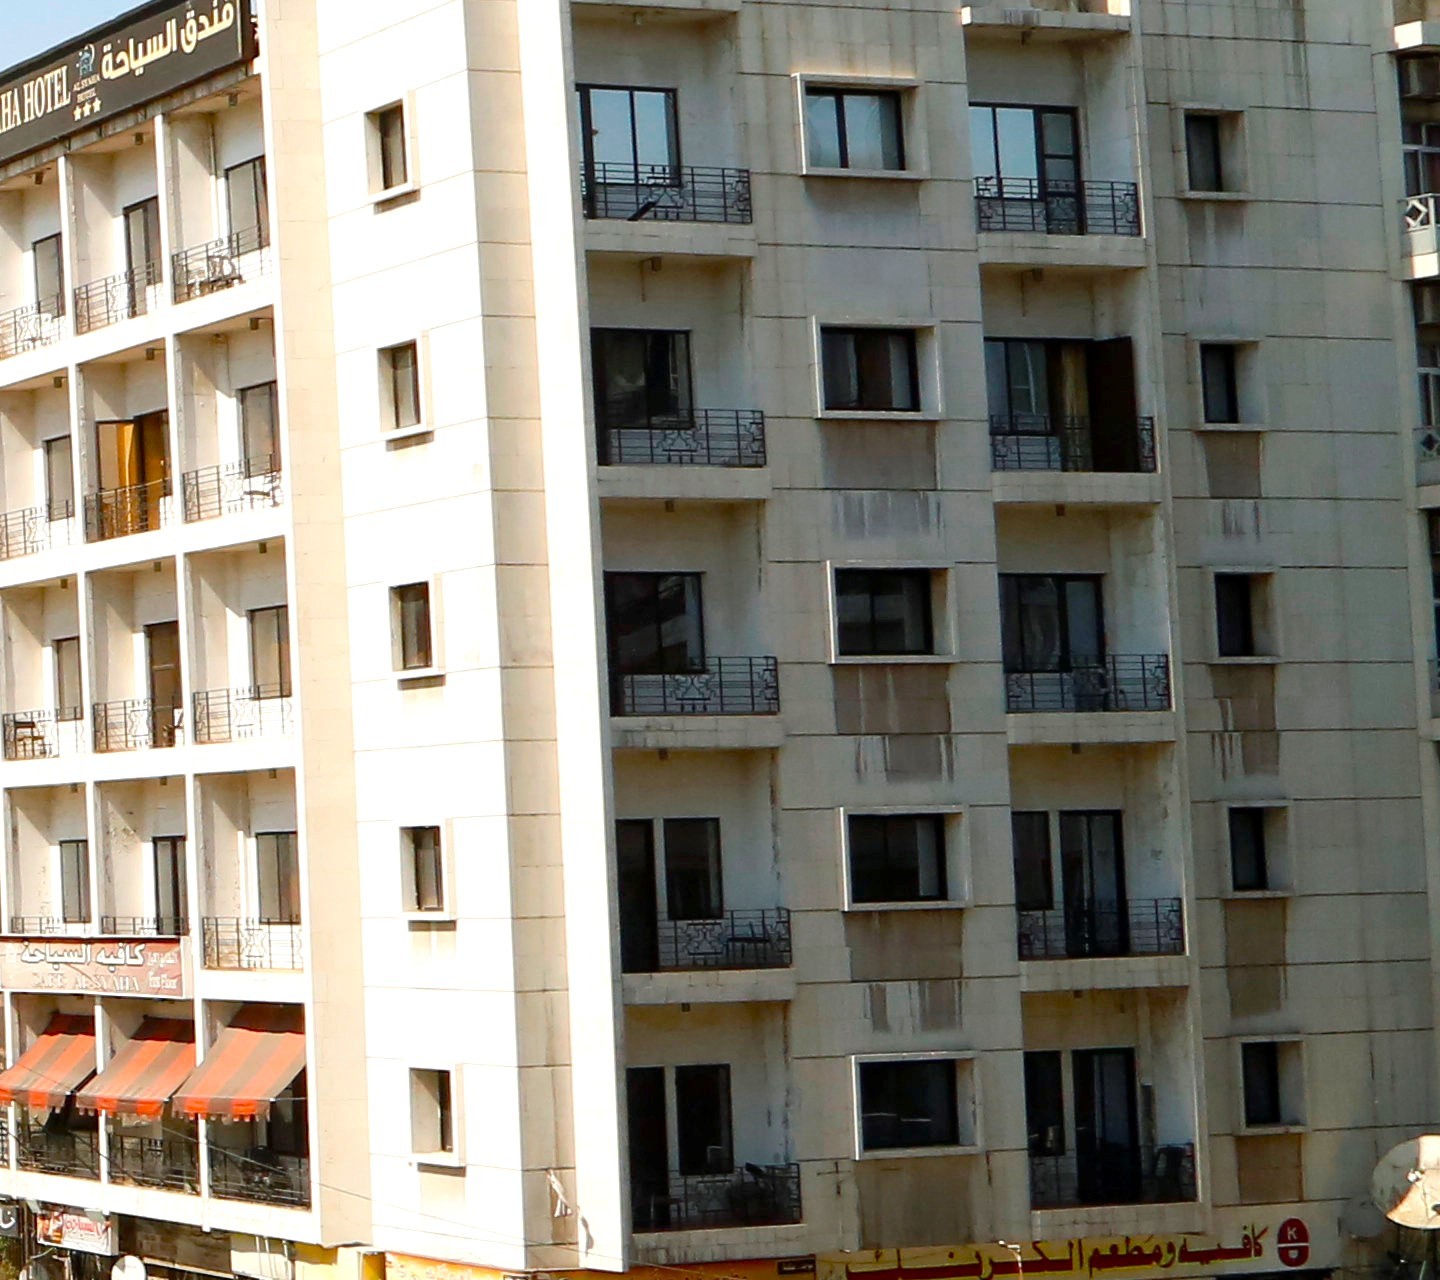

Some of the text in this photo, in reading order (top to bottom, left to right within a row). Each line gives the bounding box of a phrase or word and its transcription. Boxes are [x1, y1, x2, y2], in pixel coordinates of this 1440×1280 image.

[101, 18, 178, 81] السياحة
[22, 64, 72, 123] HOTEL
[21, 941, 92, 971] السياحة
[1180, 1223, 1267, 1275] كافيه
[1287, 1226, 1297, 1241] K
[1088, 1237, 1176, 1277] ومطعم
